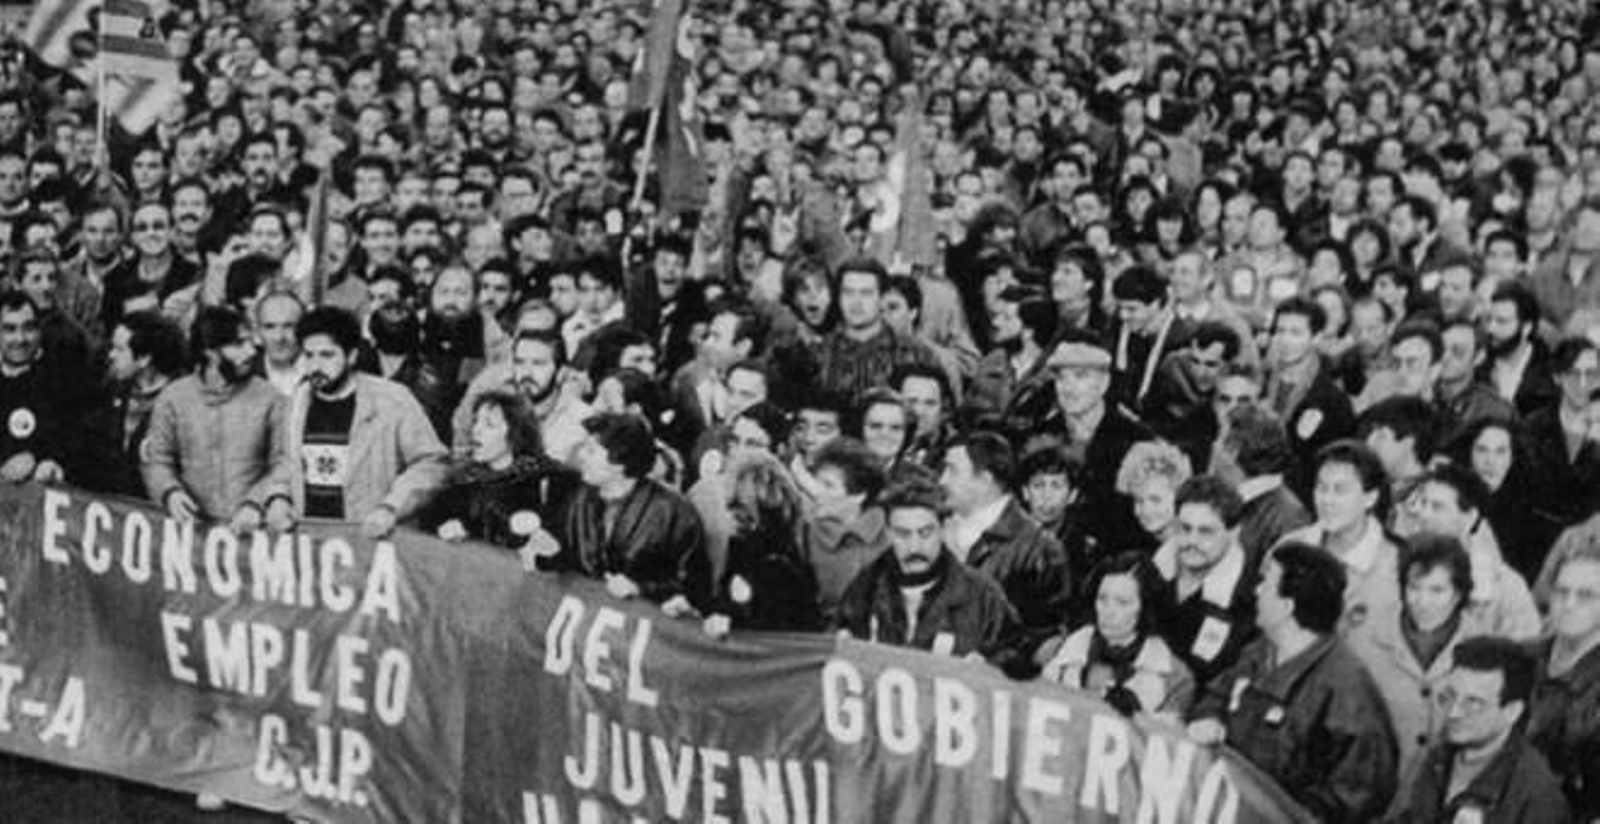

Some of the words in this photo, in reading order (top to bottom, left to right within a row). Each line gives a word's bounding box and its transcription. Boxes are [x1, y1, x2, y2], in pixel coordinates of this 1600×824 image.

[42, 489, 401, 623] ECONOMICA
[544, 595, 659, 707] DEL
[822, 659, 1239, 824] GOBIERNO
[161, 610, 411, 726] EMPLEO
